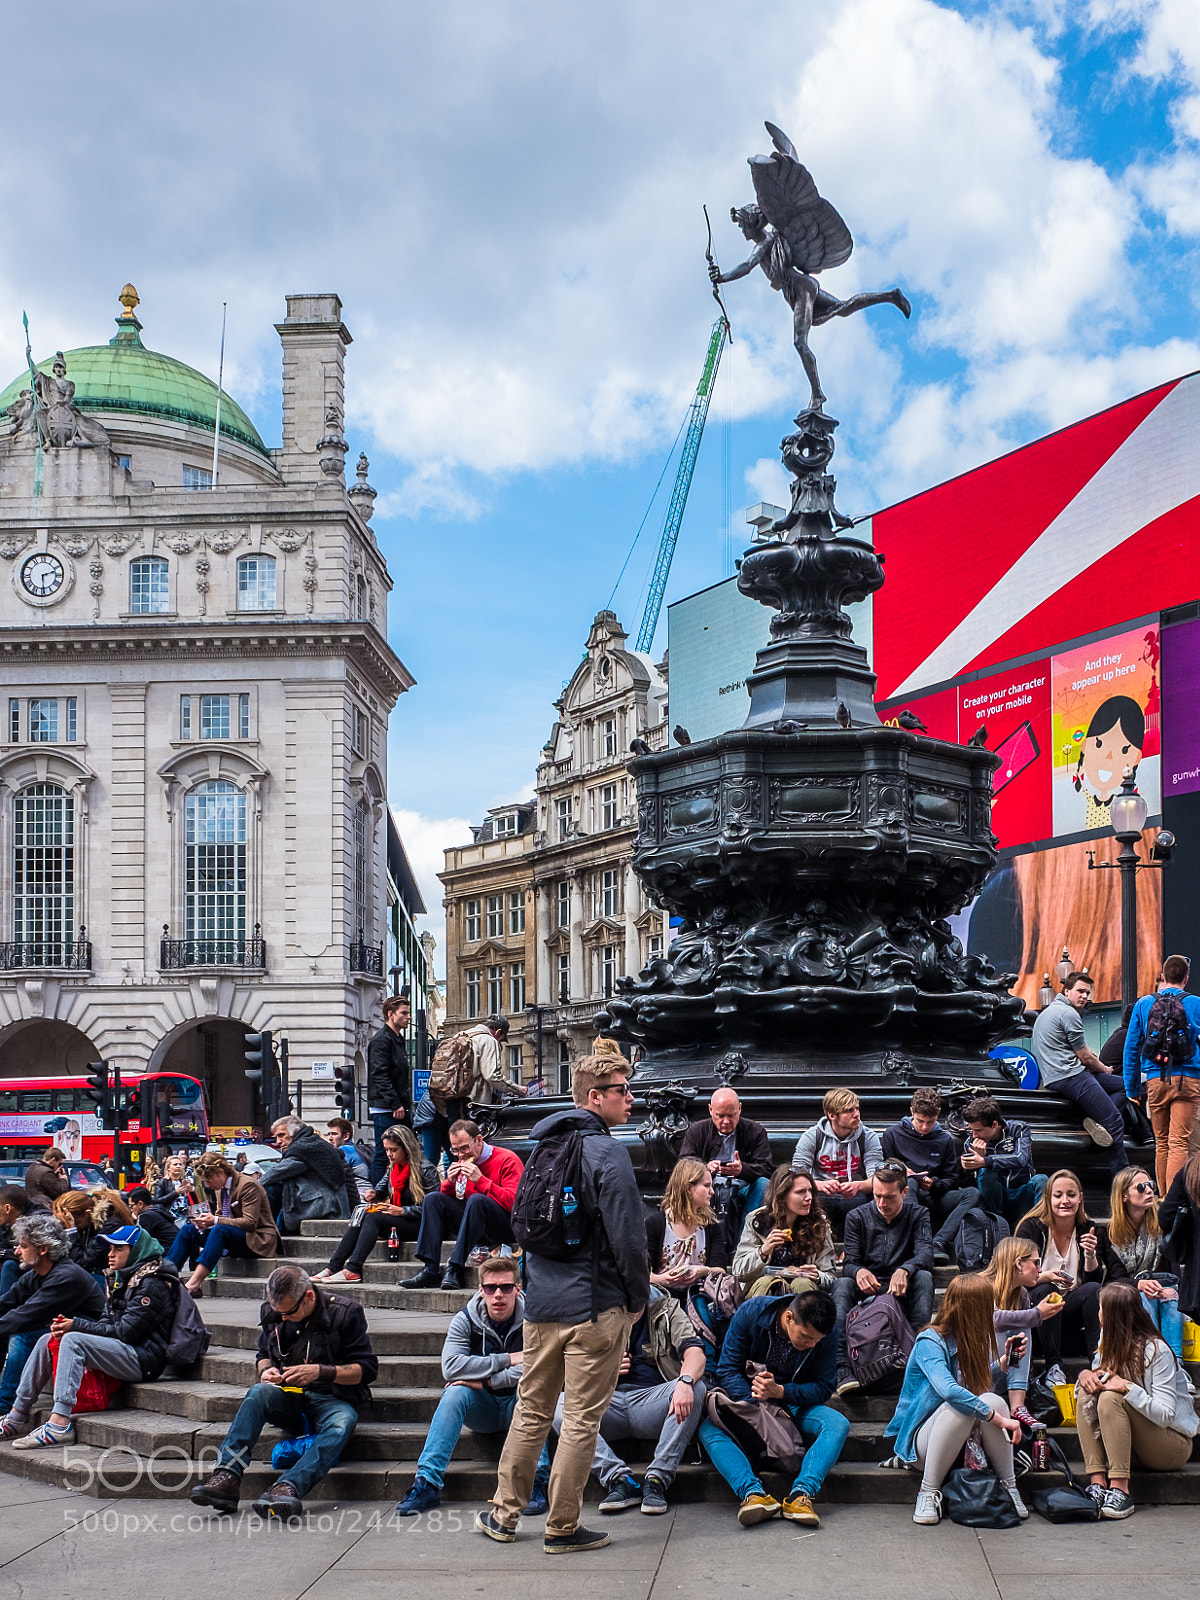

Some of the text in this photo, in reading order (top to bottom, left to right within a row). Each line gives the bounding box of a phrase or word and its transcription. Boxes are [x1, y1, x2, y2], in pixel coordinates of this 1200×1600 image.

[1084, 653, 1122, 672] And they
[1071, 663, 1136, 691] appear up here
[963, 677, 1046, 709] Create your character
[976, 695, 1032, 719] on your mobile
[121, 976, 194, 985] ALLIANCE
[188, 1121, 199, 1132] 94
